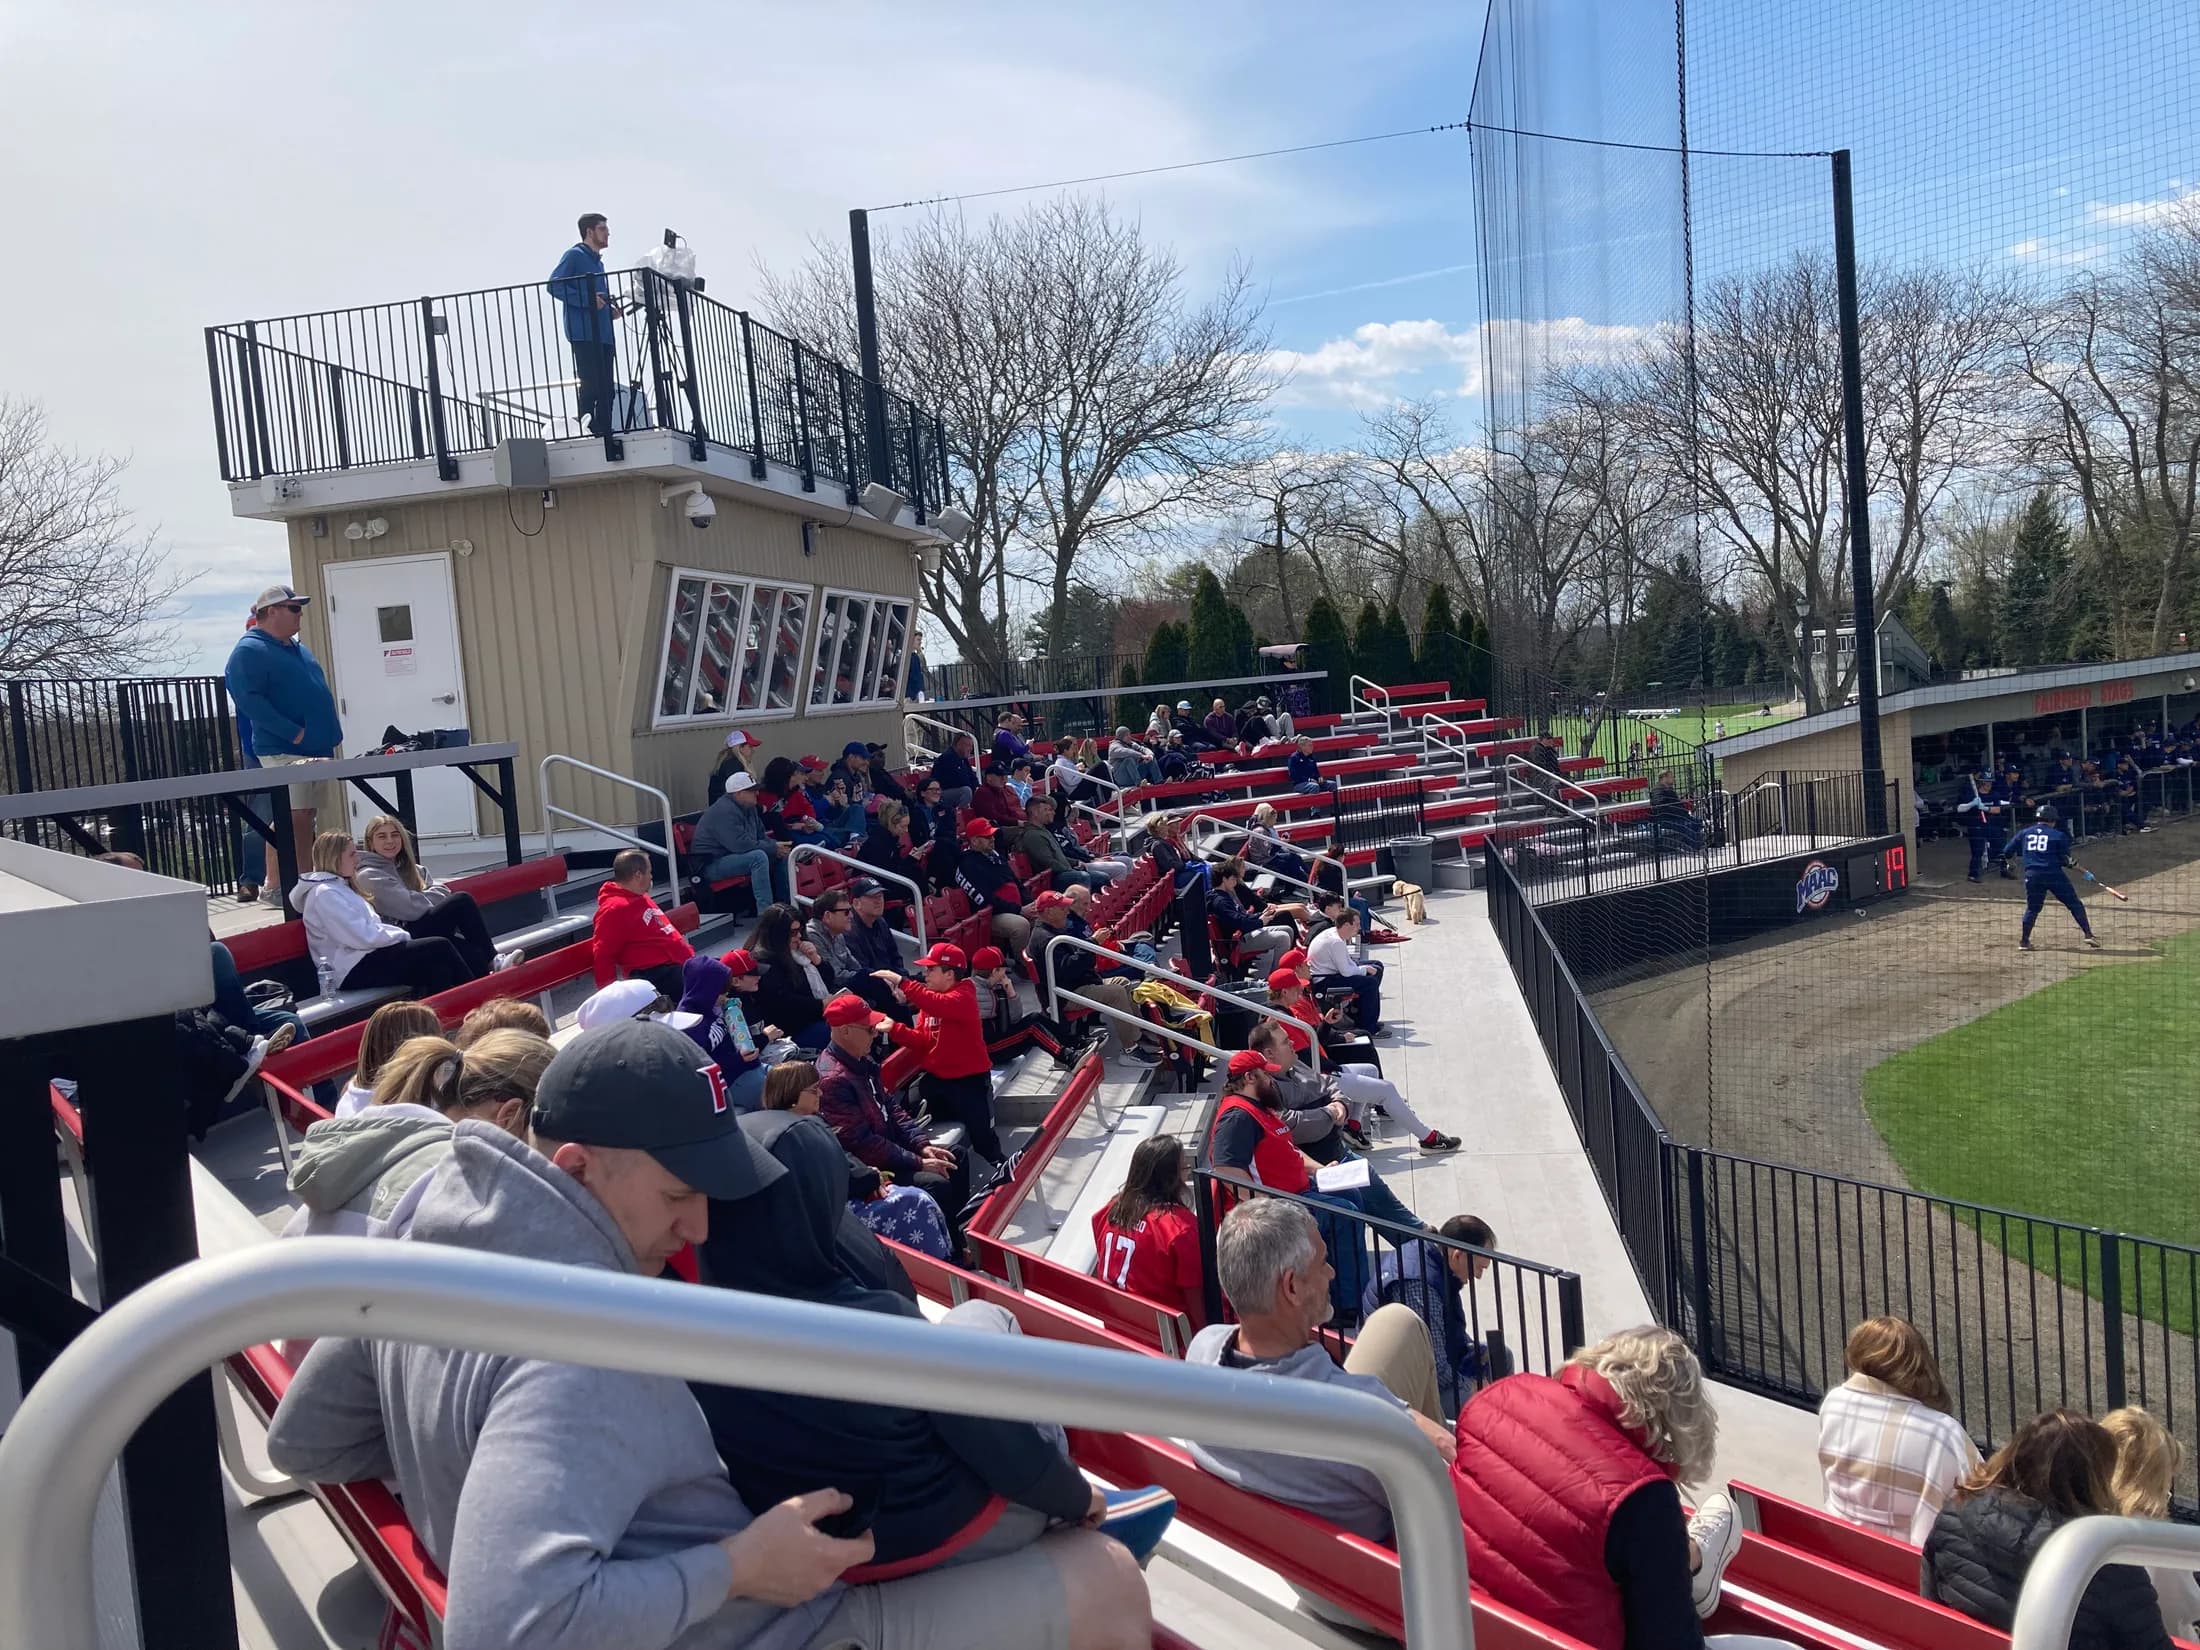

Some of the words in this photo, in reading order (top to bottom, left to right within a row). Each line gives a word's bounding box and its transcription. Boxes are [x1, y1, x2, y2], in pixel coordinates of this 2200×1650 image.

[2027, 834, 2049, 852] 28
[1796, 866, 1838, 913] MAAC
[1886, 846, 1906, 891] 19
[697, 1062, 729, 1114] F
[1103, 1232, 1136, 1289] 17
